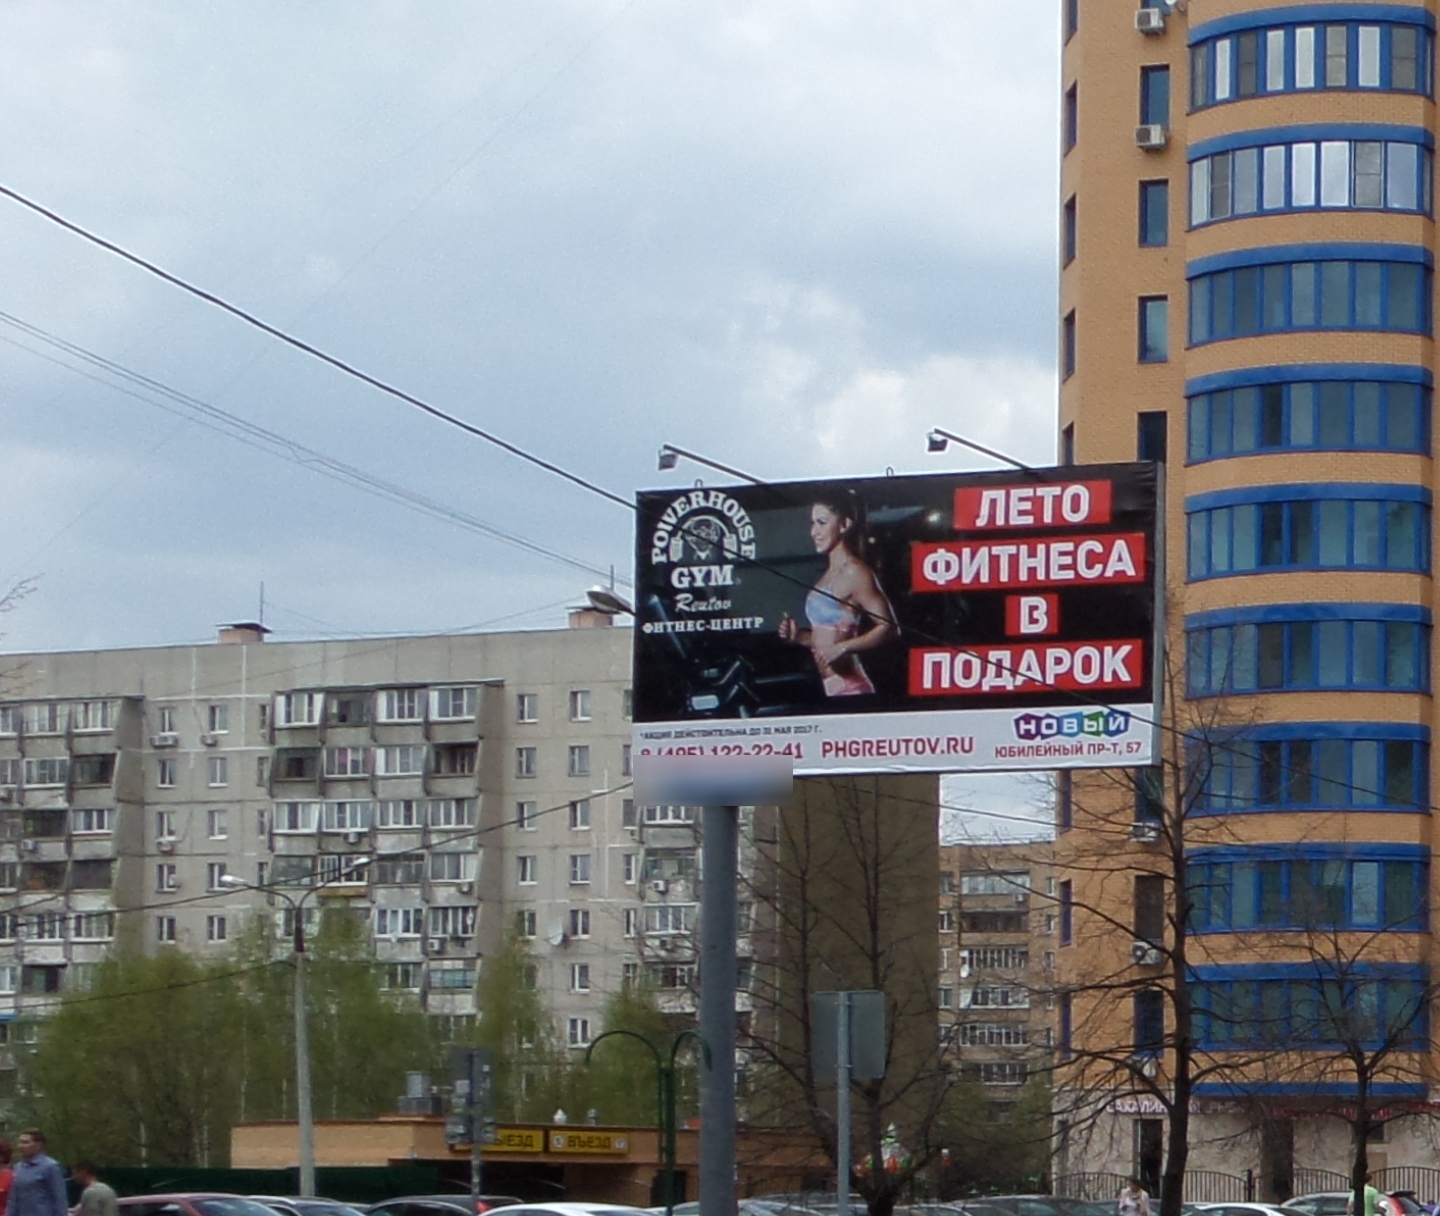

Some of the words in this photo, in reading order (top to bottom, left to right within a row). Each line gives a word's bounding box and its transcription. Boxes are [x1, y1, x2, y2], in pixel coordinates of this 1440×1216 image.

[975, 484, 1090, 527] ЛЕТО
[652, 490, 756, 565] POWERHOUSE
[923, 539, 1136, 585] ФИТНЕСА
[671, 565, 734, 589] GYM
[643, 617, 764, 634] ФИТНЕС-ЦЕНТР
[1019, 596, 1048, 634] В
[923, 645, 1133, 692] ПОДАРОК
[1018, 713, 1128, 737] НОВЫЙ
[821, 737, 974, 759] PHGREUTOV.RU
[995, 741, 1084, 759] ЮБИЛЕЙНЫЙ
[1087, 742, 1123, 757] ПР-Т,
[1126, 742, 1142, 754] 57
[568, 1135, 611, 1149] ВЪЕЗД
